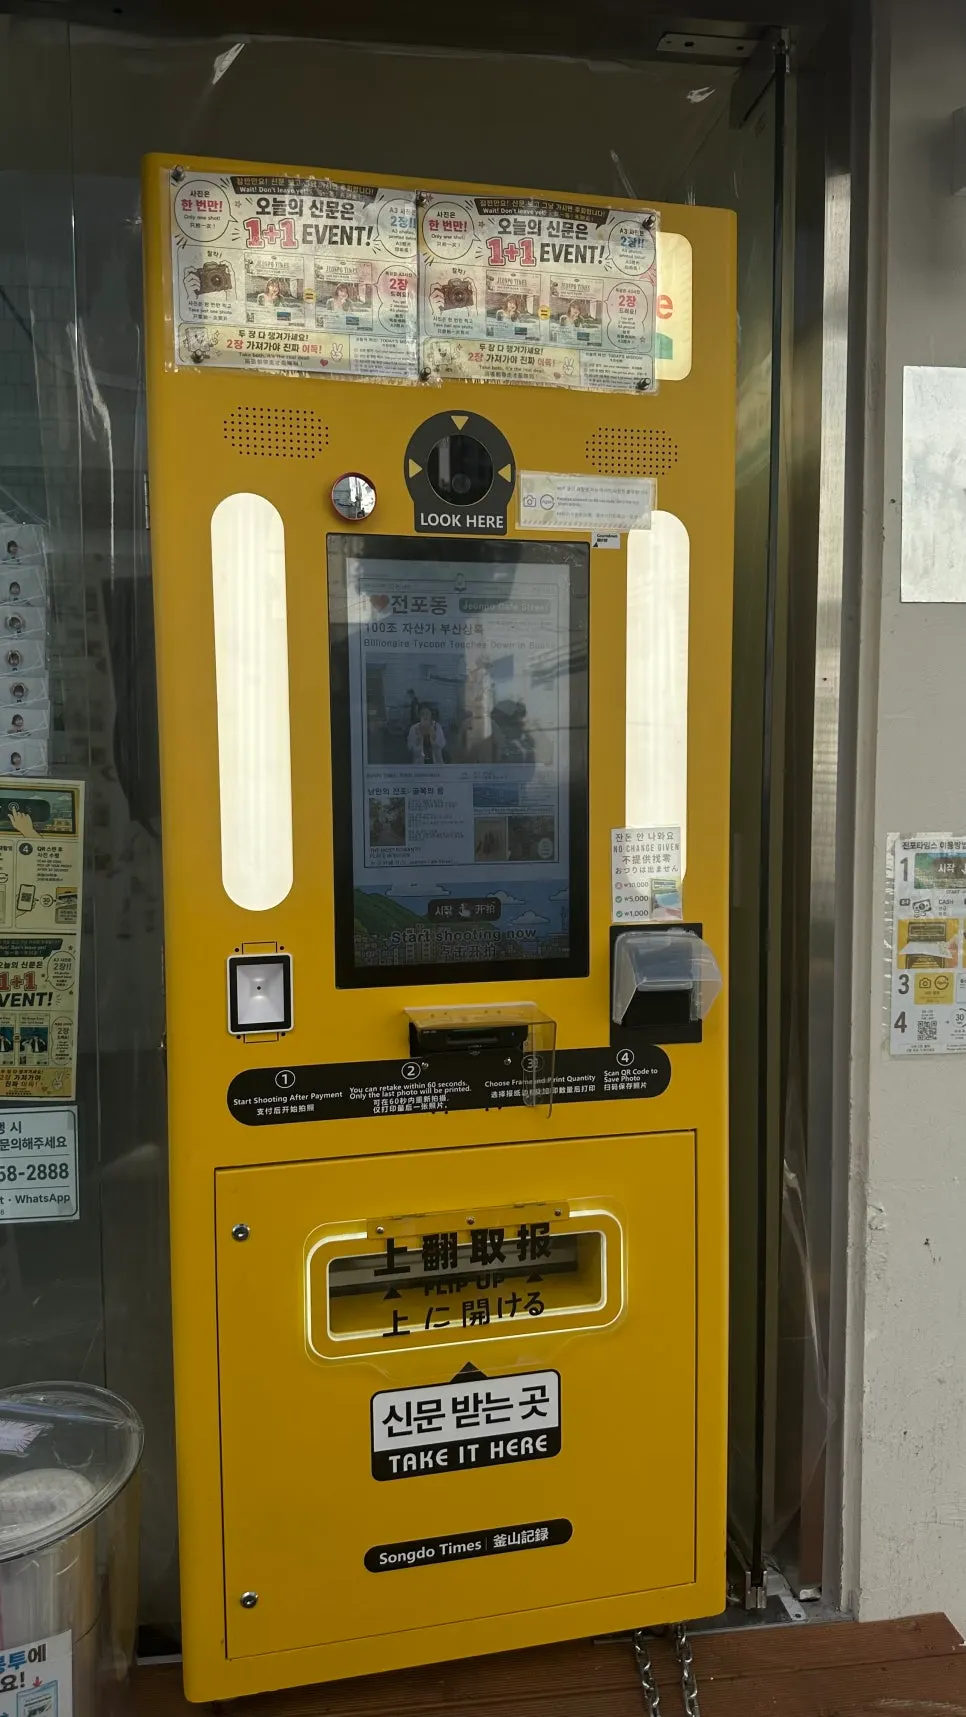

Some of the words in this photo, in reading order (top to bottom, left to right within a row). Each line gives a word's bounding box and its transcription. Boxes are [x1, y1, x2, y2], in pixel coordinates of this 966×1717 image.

[190, 190, 210, 198] 사진은
[259, 186, 277, 194] Don't
[181, 199, 192, 212] 한
[195, 200, 223, 213] 번만!
[255, 197, 304, 218] 오늘의
[308, 199, 355, 221] 신문은
[388, 206, 398, 214] A3
[482, 207, 499, 215] Wait!
[437, 211, 456, 219] 사진은
[243, 216, 299, 249] 1+1
[301, 223, 374, 247] EVENT!
[429, 219, 440, 232] 한
[442, 220, 468, 233] 번만!
[497, 217, 542, 236] 오늘의
[546, 220, 589, 241] 신문은
[620, 235, 645, 249] 2장!!
[486, 236, 537, 267] 1+1
[539, 242, 606, 265] EVENT!
[389, 278, 408, 291] 2장
[618, 295, 637, 307] 2장
[238, 329, 246, 338] 두
[248, 330, 256, 339] 장
[258, 331, 266, 340] 다
[267, 332, 309, 342] 챙겨가세요!
[226, 339, 244, 350] 2장
[246, 340, 281, 352] 가져가야
[282, 343, 300, 353] 진짜
[301, 344, 322, 354] 이득!
[479, 343, 486, 352] 두
[488, 344, 495, 352] 장
[497, 344, 505, 352] 다
[506, 345, 544, 356] 챙겨가세요!
[468, 351, 483, 362] 2장
[486, 353, 518, 364] 가져가야
[520, 356, 536, 366] 진짜
[537, 358, 556, 368] 이득!
[420, 512, 462, 528] LOOK
[466, 514, 504, 529] HERE
[391, 594, 448, 616] 전포동
[365, 622, 398, 634] 100조
[402, 623, 436, 635] 자산가
[364, 639, 410, 648] Billionaire
[413, 639, 446, 649] Tycoon
[449, 640, 487, 649] Touches
[490, 641, 515, 650] Down
[615, 833, 633, 843] 잔돈
[636, 832, 645, 842] 안
[647, 831, 675, 841] 나와요
[613, 845, 623, 853] NO
[625, 844, 655, 853] CHANGE
[657, 843, 680, 851] GIVEN
[902, 841, 938, 850] 전포타임스
[622, 853, 672, 865] 不提供找零
[615, 865, 679, 875] おつりは出ません
[900, 857, 909, 882] 1
[937, 863, 956, 874] 시작
[435, 905, 452, 918] 시작
[390, 929, 431, 944] Start
[436, 928, 500, 943] shooting
[506, 927, 537, 940] now
[21, 961, 43, 969] 신문은
[53, 962, 72, 971] 2장!!
[898, 973, 910, 995] 3
[893, 1010, 908, 1034] 4
[955, 1013, 965, 1021] 30
[349, 1087, 363, 1095] You
[379, 1084, 402, 1092] retake
[437, 1080, 468, 1088] seconds.
[484, 1080, 511, 1088] Choose
[566, 1075, 596, 1083] Quantity
[604, 1082, 648, 1091] 扫码保存照片
[233, 1098, 252, 1106] Start
[253, 1096, 288, 1105] Shooting
[310, 1091, 343, 1101] Payment
[349, 1093, 367, 1101] Only
[381, 1090, 395, 1098] last
[396, 1089, 418, 1099] photo
[419, 1087, 432, 1095] will
[433, 1086, 443, 1094] be
[444, 1086, 472, 1096] printed.
[256, 1103, 315, 1116] 支付后开始拍照
[9, 1120, 22, 1134] 시
[14, 1193, 71, 1205] WhatsApp
[373, 1221, 552, 1277] 上翻取报
[424, 1277, 469, 1297] FLIP
[476, 1273, 505, 1290] UP
[382, 1291, 545, 1338] 上に開ける
[382, 1398, 446, 1438] 신문
[451, 1391, 514, 1430] 받는
[518, 1384, 550, 1420] 곳
[388, 1448, 449, 1474] TAKE
[458, 1443, 480, 1465] IT
[489, 1434, 549, 1460] HERE
[379, 1546, 436, 1565] Songdo
[439, 1540, 482, 1557] Times
